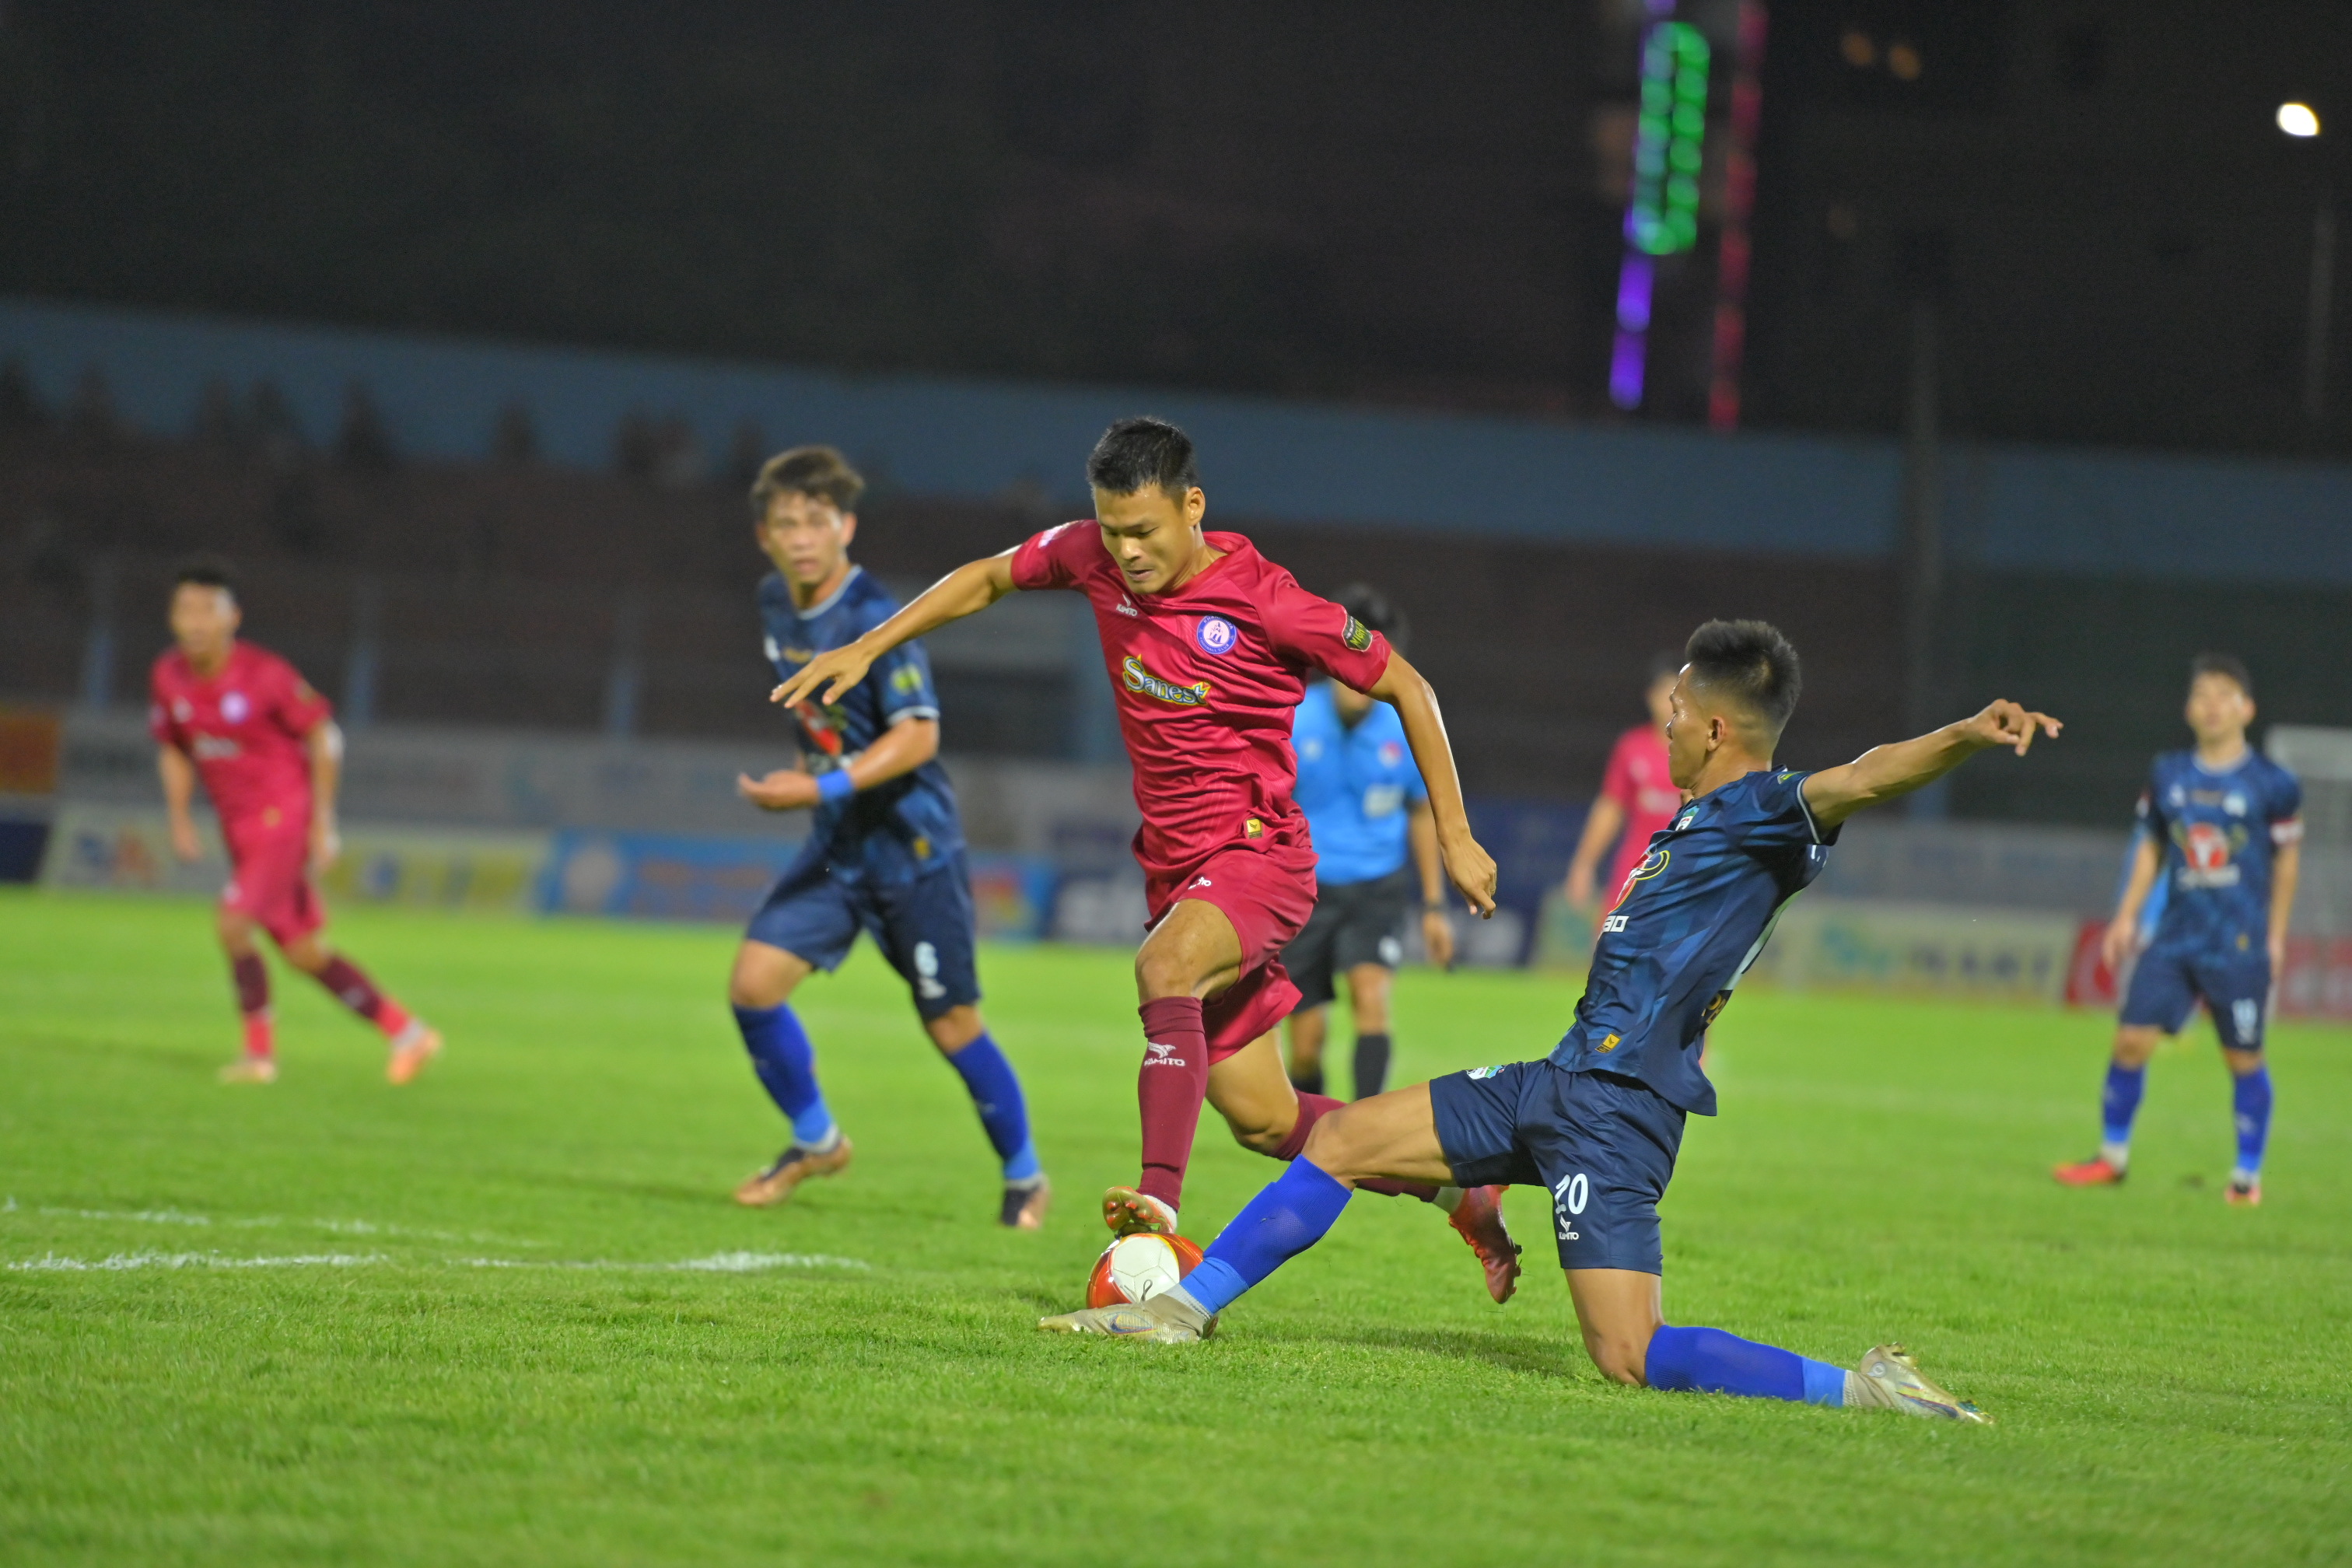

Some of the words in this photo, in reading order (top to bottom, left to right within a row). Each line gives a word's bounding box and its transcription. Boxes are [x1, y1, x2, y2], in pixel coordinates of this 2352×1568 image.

[1123, 655, 1211, 706] Sanest
[1555, 1173, 1589, 1215] 20
[1559, 1231, 1580, 1241] KAMITO
